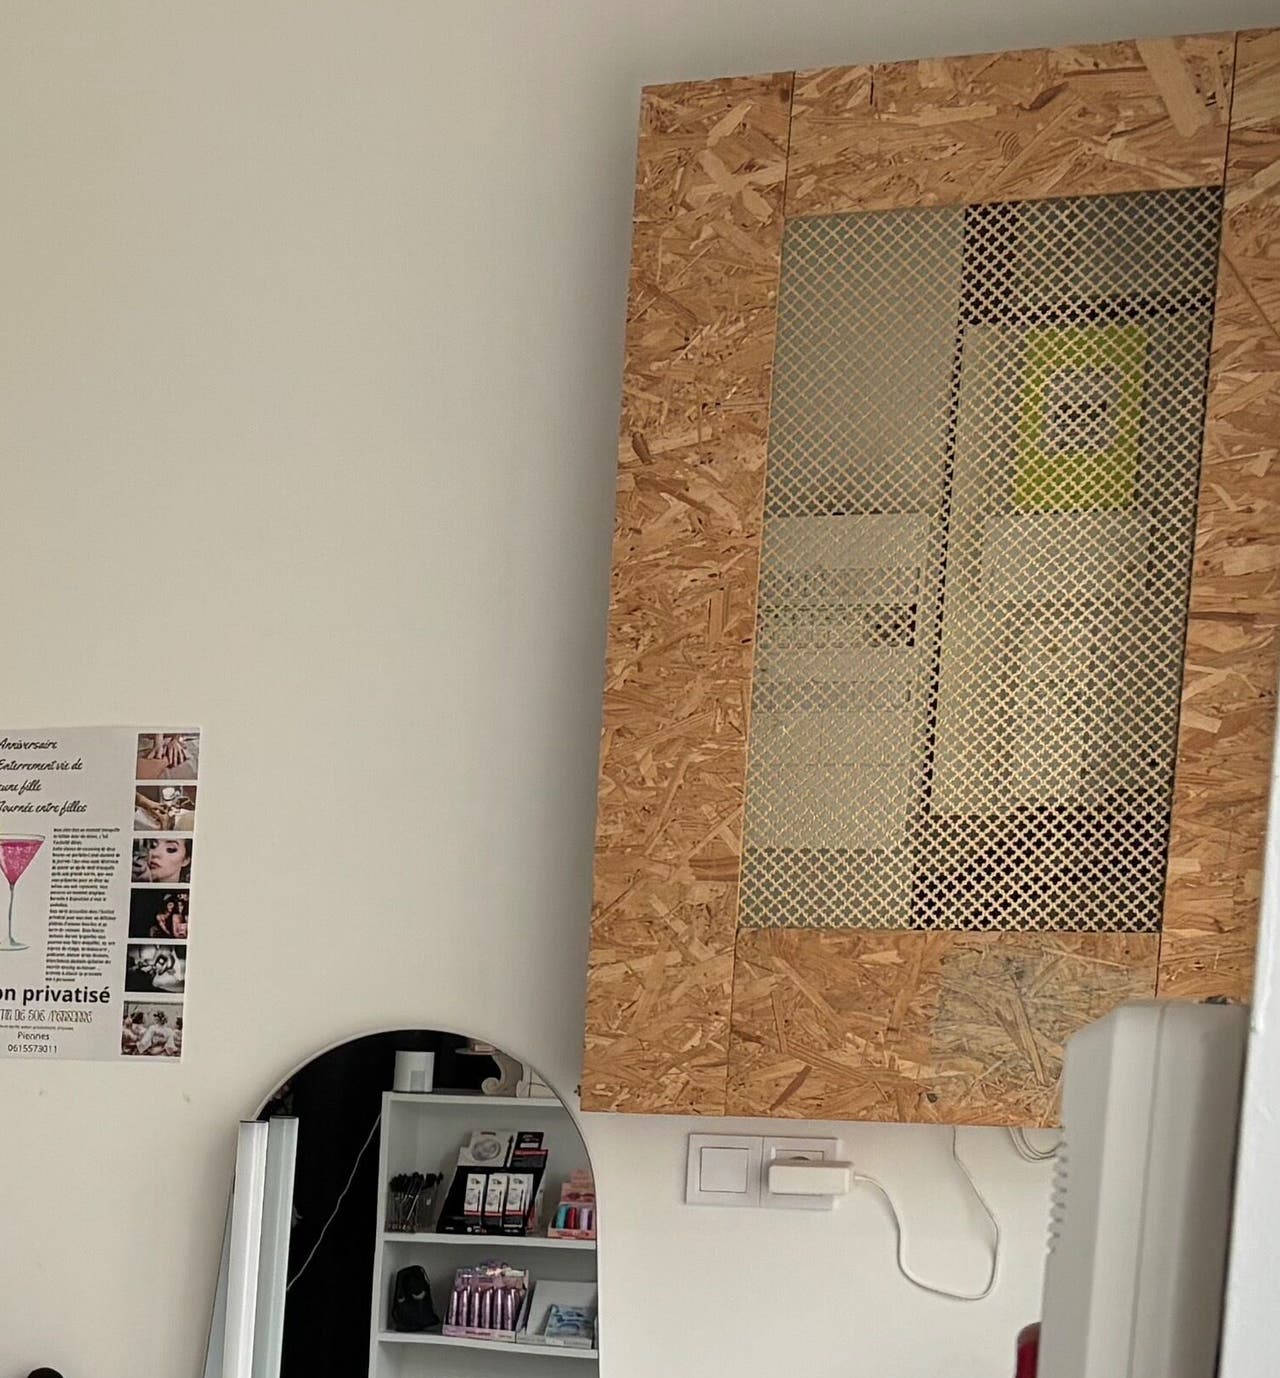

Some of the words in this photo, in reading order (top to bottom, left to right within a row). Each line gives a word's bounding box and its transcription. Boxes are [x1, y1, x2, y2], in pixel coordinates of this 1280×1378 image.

[56, 759, 69, 771] vie
[71, 757, 84, 771] de
[18, 779, 42, 796] fille
[34, 803, 59, 814] entre
[59, 801, 88, 817] filles
[23, 985, 111, 1006] privatisé
[17, 1031, 50, 1041] Piennes
[7, 1044, 57, 1054] 0615573011
